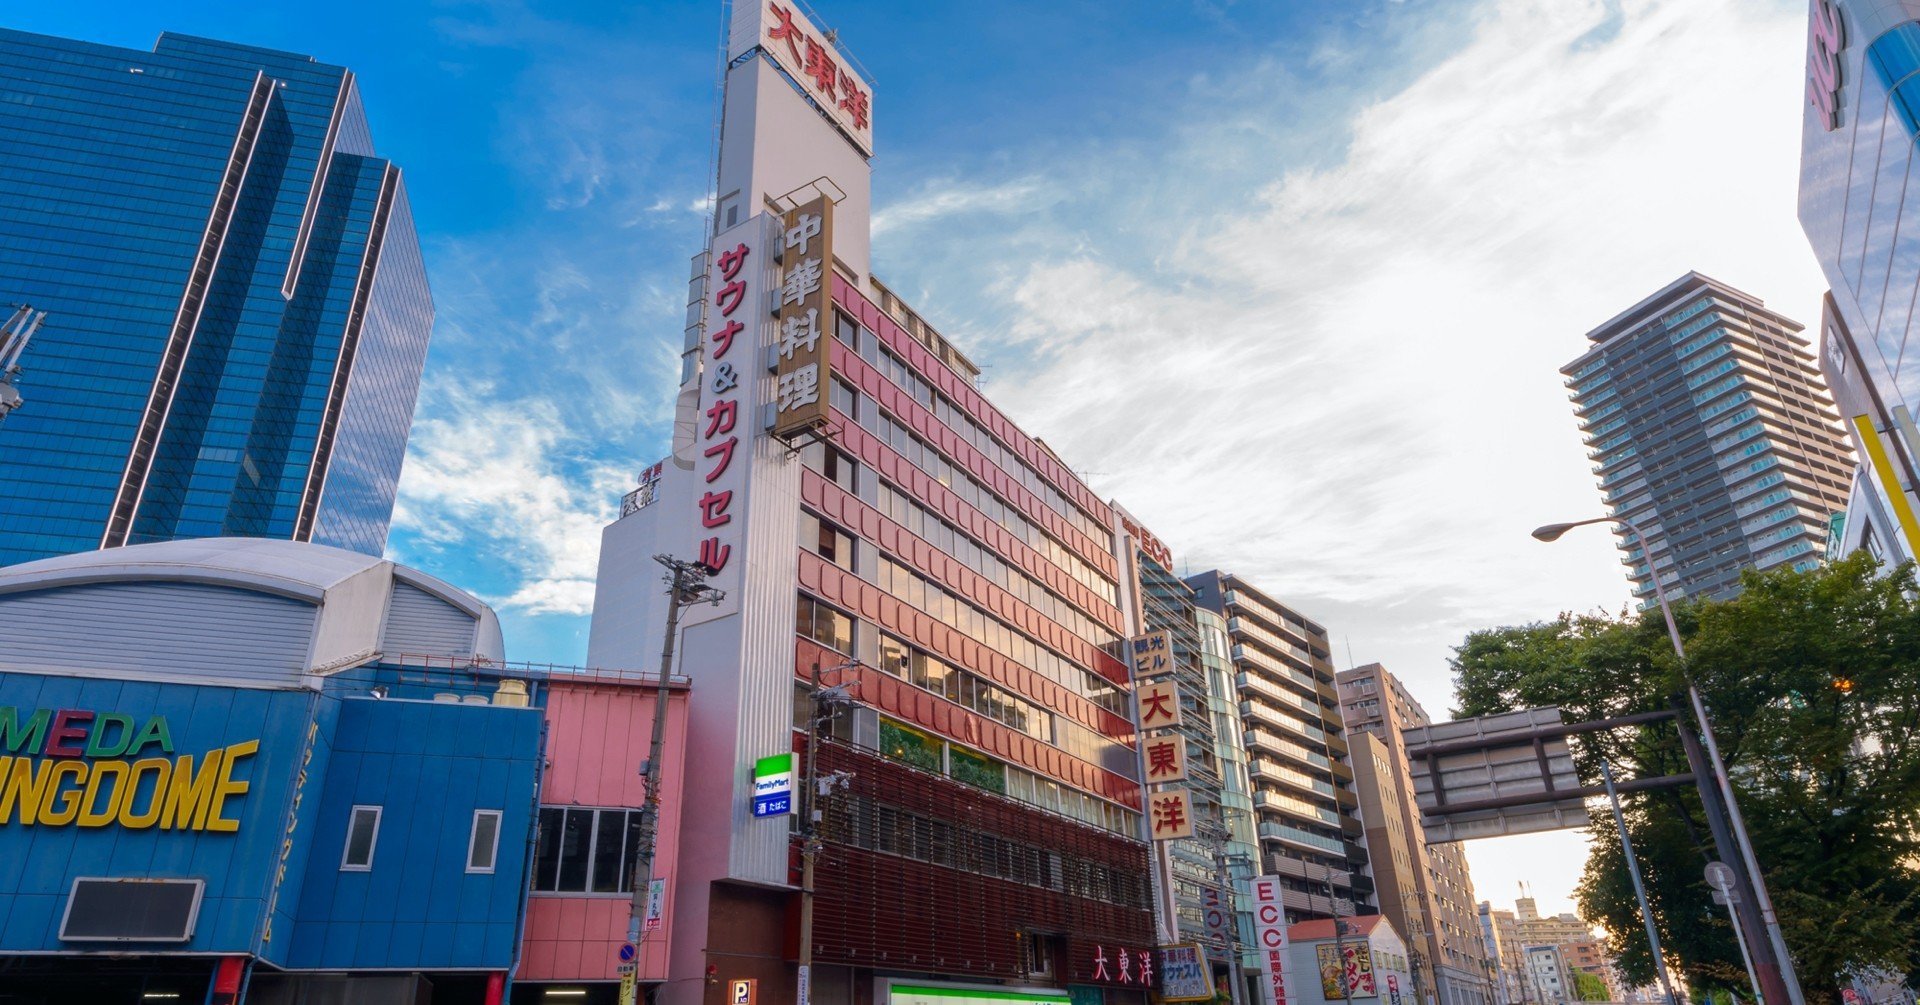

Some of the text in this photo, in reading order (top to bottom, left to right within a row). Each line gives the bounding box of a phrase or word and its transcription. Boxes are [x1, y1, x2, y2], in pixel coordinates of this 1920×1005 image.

[768, 1, 869, 131] 大東洋
[778, 213, 823, 414] 中華料理
[699, 243, 750, 573] サウナ&カプセル
[1140, 526, 1173, 573] ECC
[1134, 635, 1165, 654] 観光
[1135, 654, 1167, 673] ビル
[1142, 688, 1185, 833] 大東洋
[755, 778, 789, 791] FamilyMart
[757, 800, 787, 814] 酒 たばこ
[1257, 882, 1282, 948] ECC
[1093, 945, 1154, 987] 大東洋
